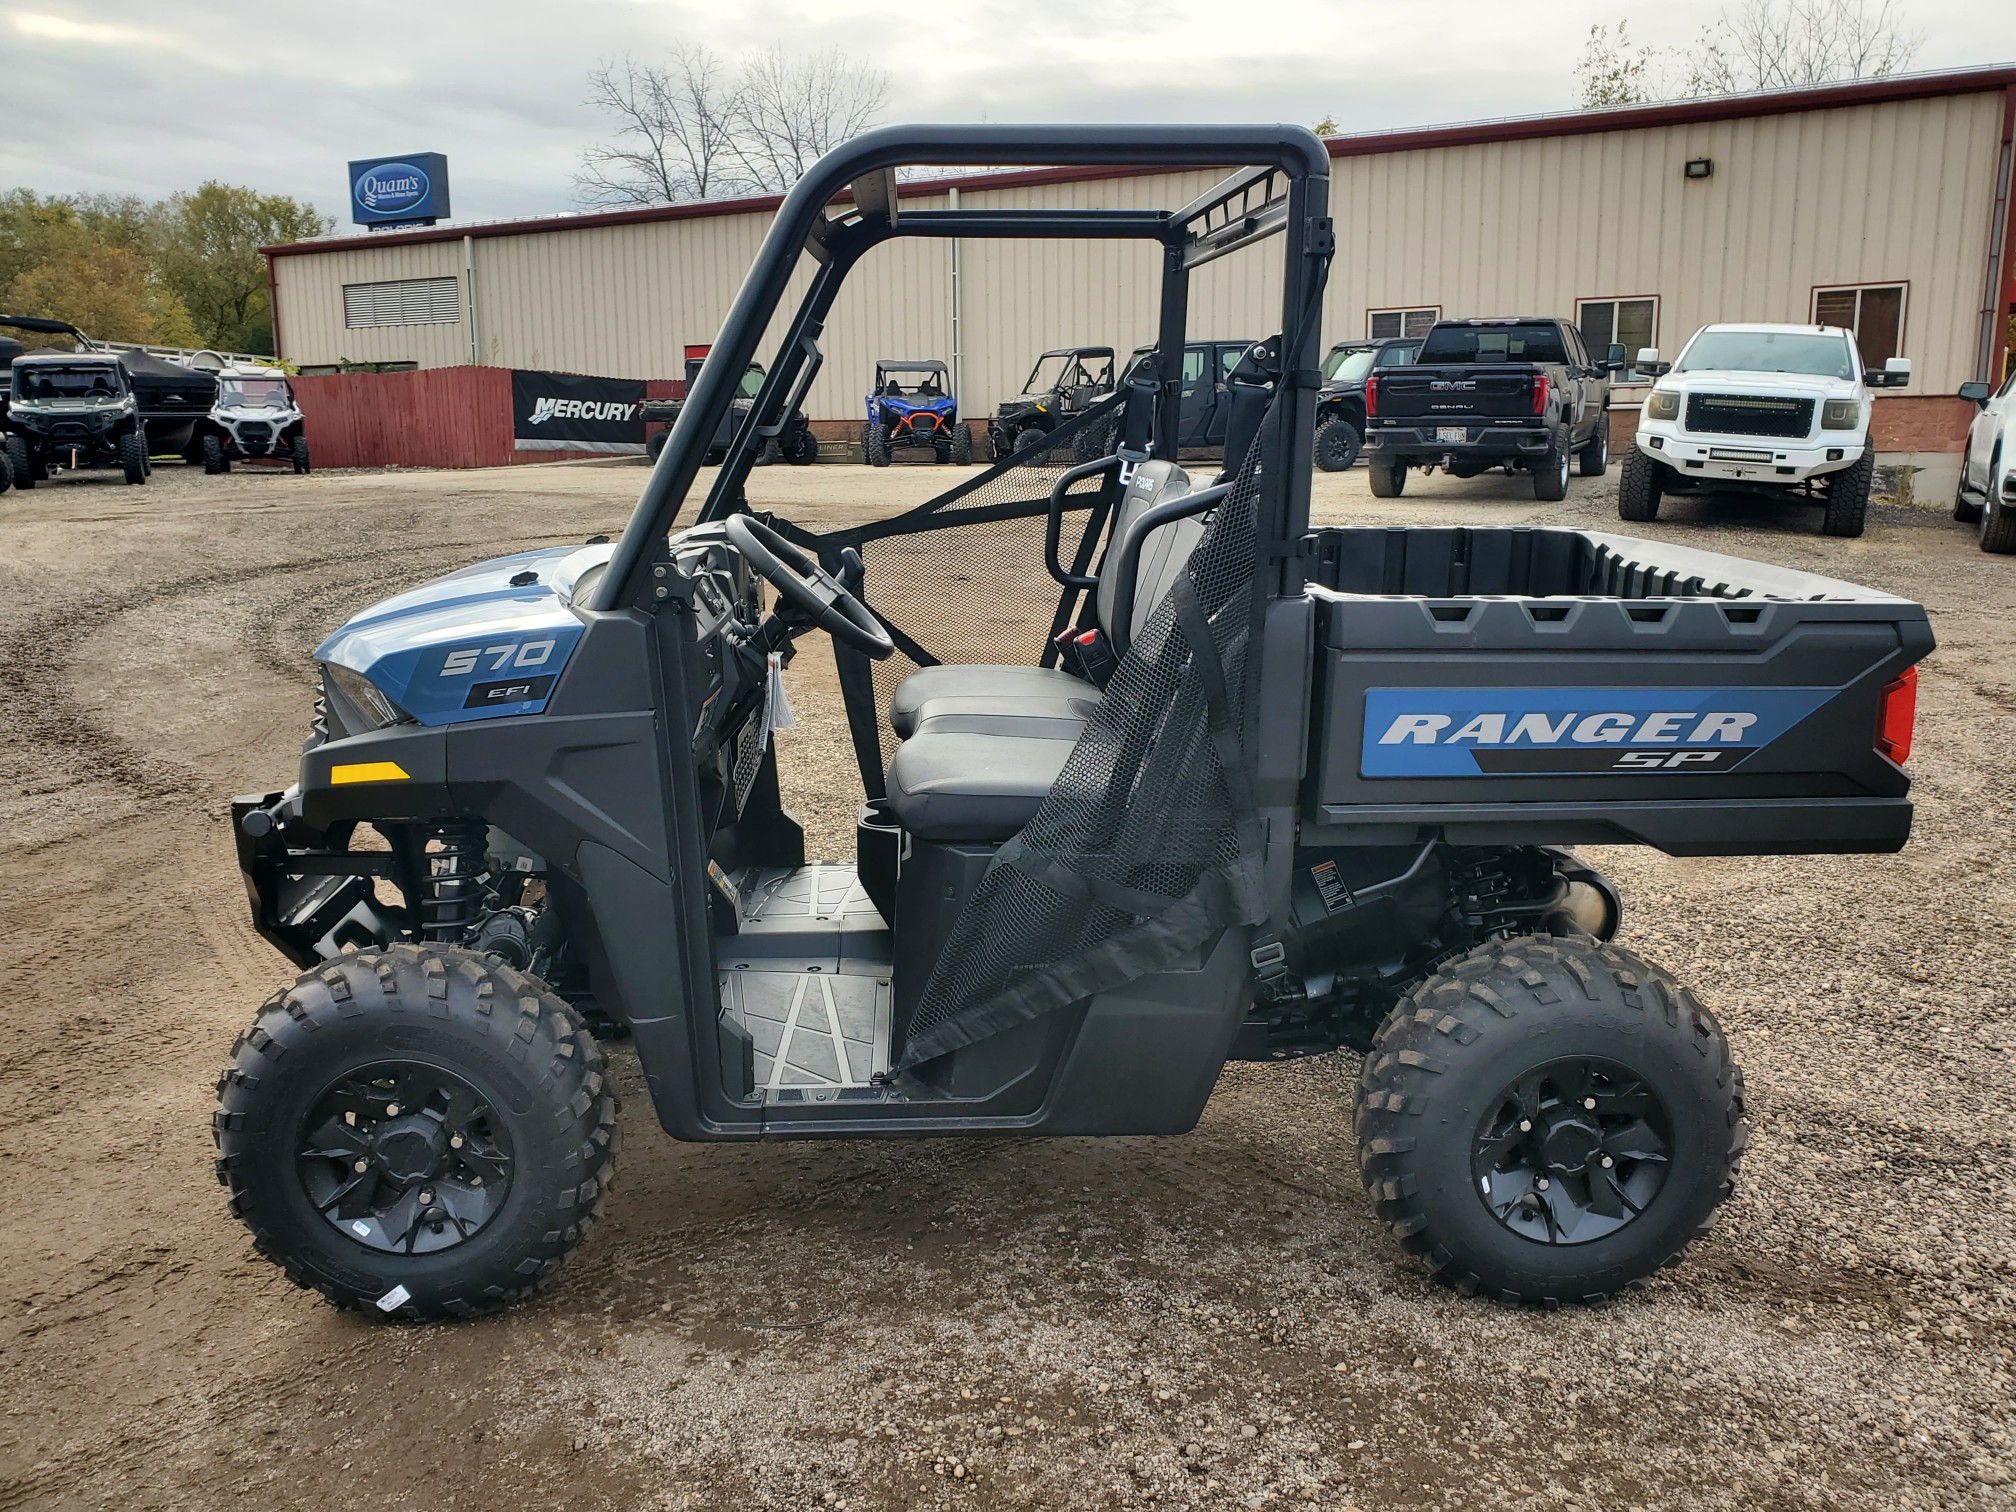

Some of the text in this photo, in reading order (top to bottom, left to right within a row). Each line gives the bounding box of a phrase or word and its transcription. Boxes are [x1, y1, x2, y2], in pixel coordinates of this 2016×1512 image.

[364, 176, 419, 195] Quam's
[1430, 381, 1476, 391] GMC
[533, 397, 637, 422] MERCURY
[440, 640, 556, 677] 570
[487, 685, 531, 698] EFI
[1377, 712, 1759, 745] RANGER
[1611, 751, 1723, 769] SP
